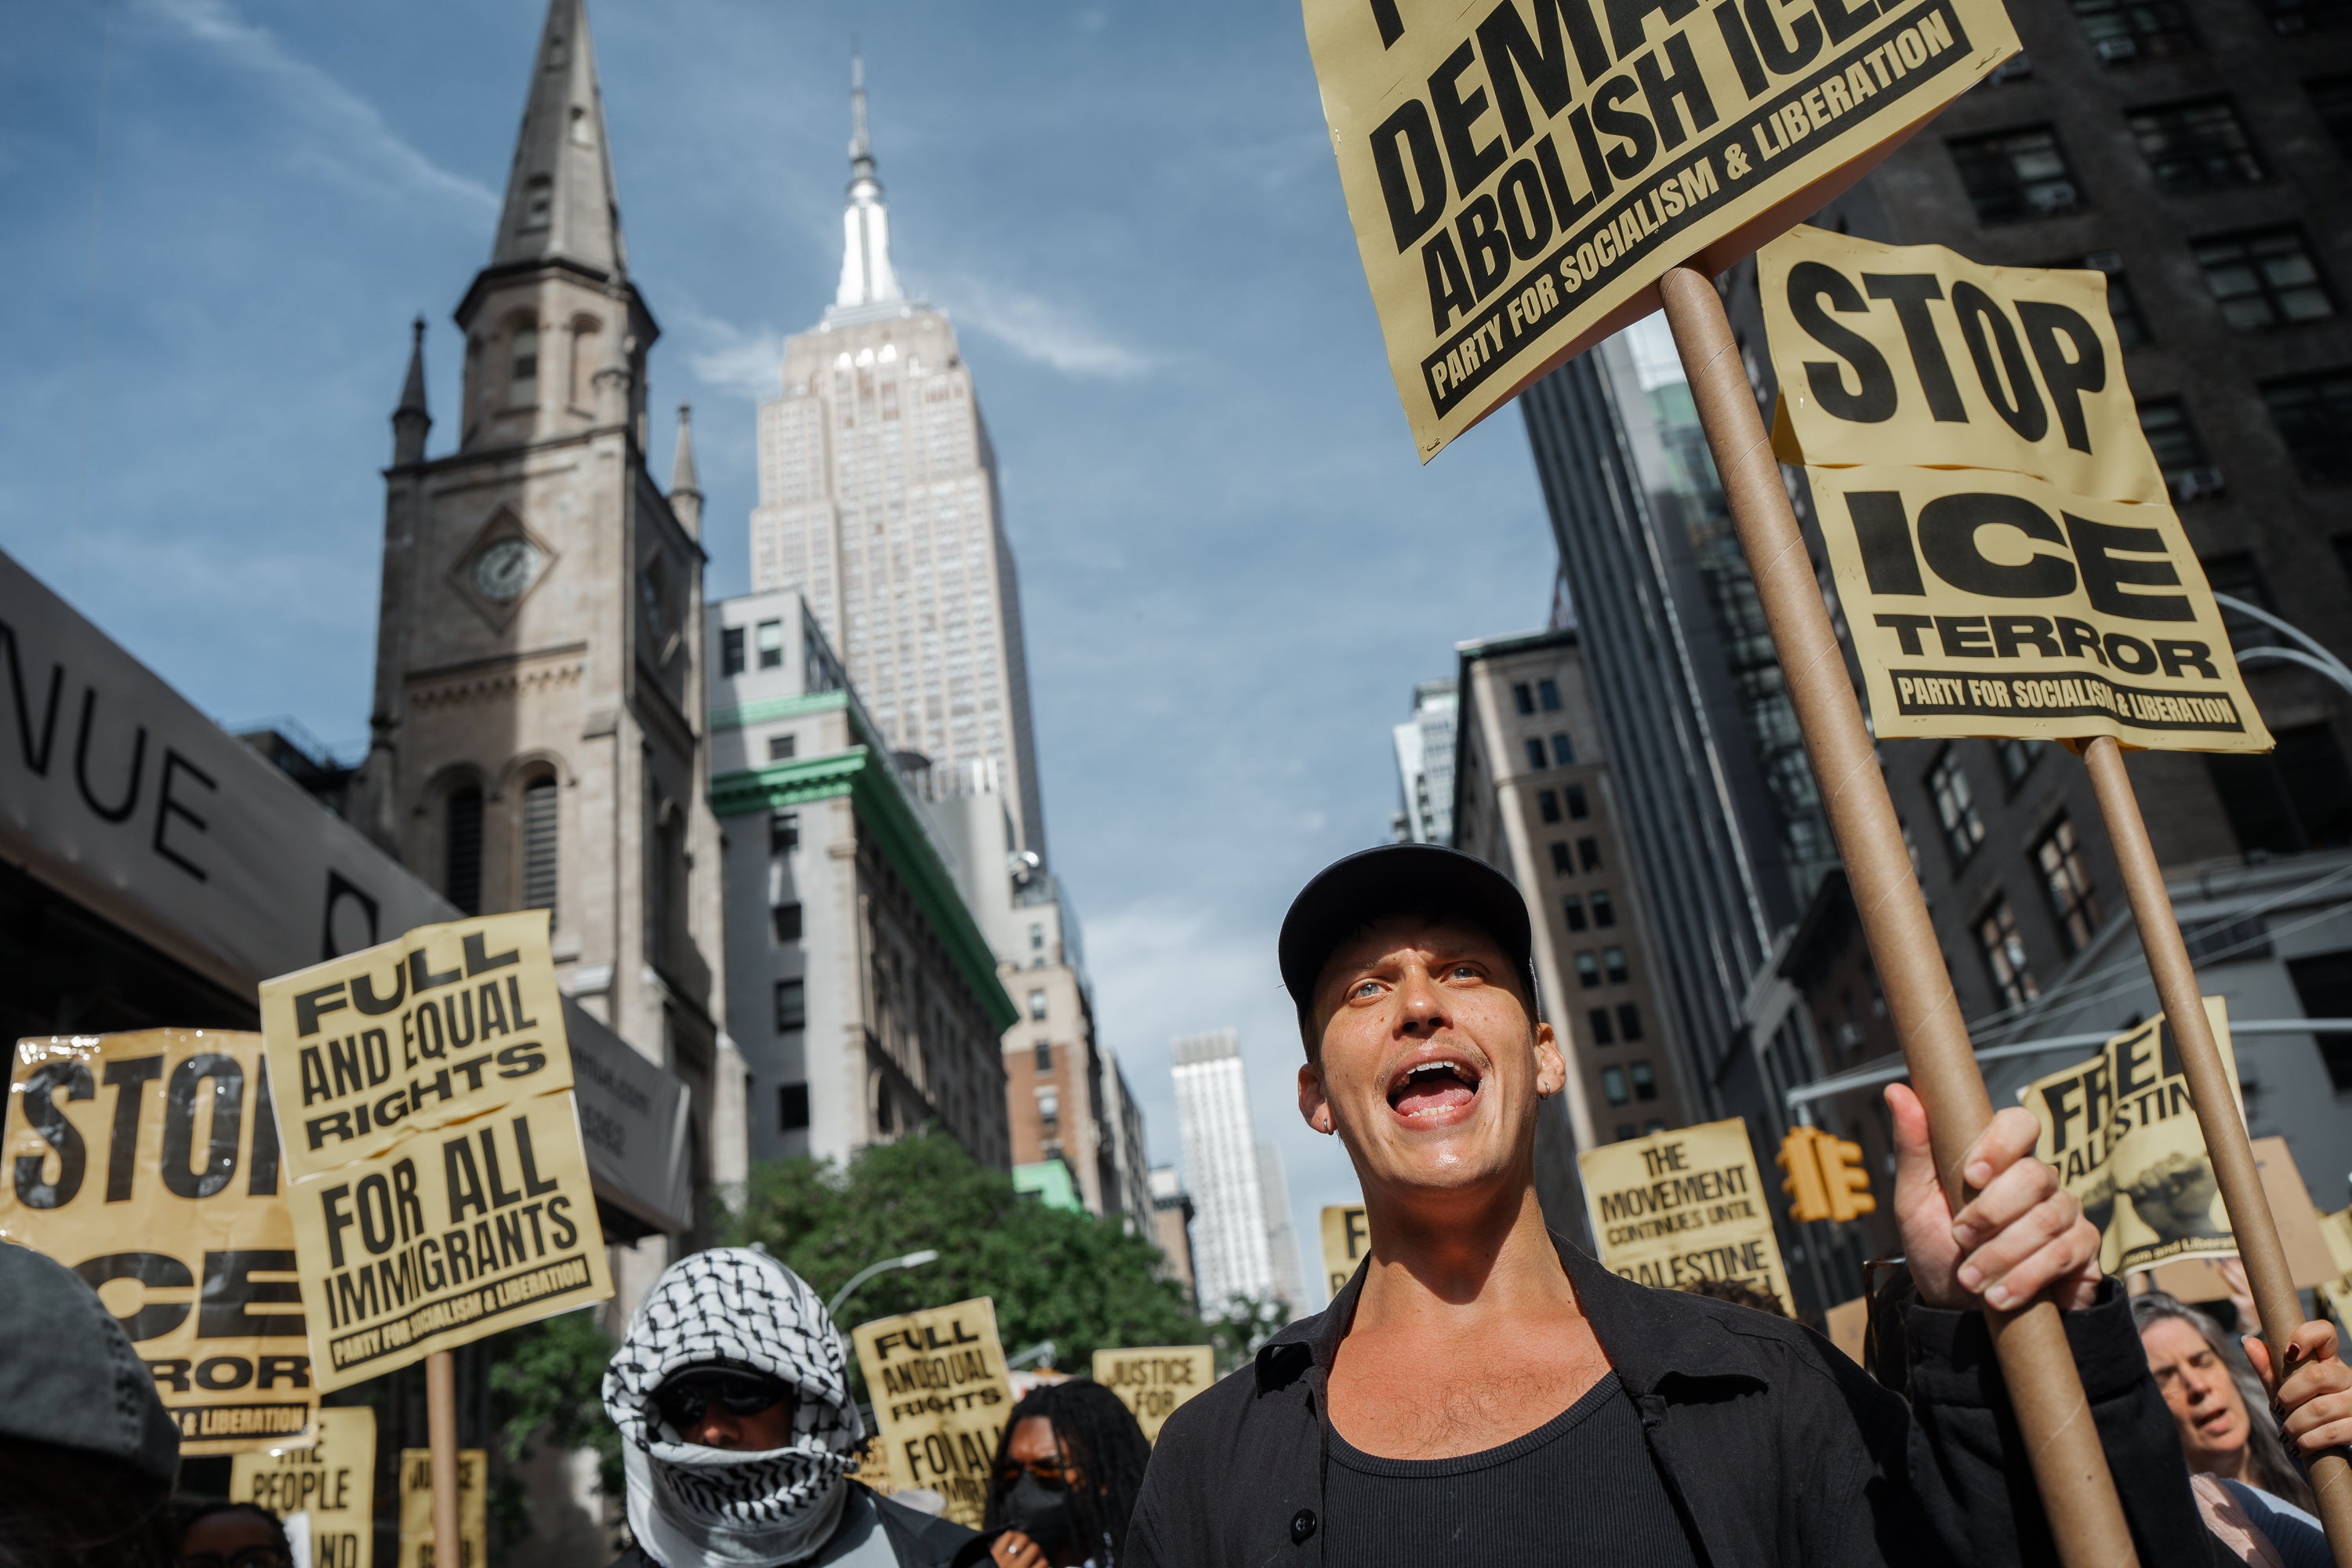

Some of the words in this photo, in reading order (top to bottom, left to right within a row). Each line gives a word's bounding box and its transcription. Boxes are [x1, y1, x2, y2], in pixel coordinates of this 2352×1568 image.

[1370, 0, 1701, 255] DEM
[1421, 29, 1720, 338] ABOLISH
[1431, 314, 1504, 400] PARTY
[1507, 274, 1559, 337] FOR
[1560, 156, 1719, 293] SOCIALISM
[1724, 143, 1753, 180] &
[1752, 9, 1955, 162] LIBERATION
[1787, 260, 2107, 456] STOP
[1843, 491, 2198, 622] ICE
[1873, 614, 2221, 679] TERROR
[1897, 676, 1965, 706] PARTY
[1969, 677, 2012, 707] FOR
[2014, 678, 2116, 711] SOCIALISM
[2116, 692, 2132, 717] &
[2132, 692, 2238, 724] LIBERATION
[294, 930, 521, 1038] FULL
[300, 1026, 391, 1107] AND
[404, 974, 537, 1069] EQUAL
[304, 1040, 547, 1152] RIGHTS
[1641, 1142, 1690, 1177] THE
[320, 1156, 426, 1270] FOR
[442, 1115, 558, 1225] ALL
[1600, 1166, 1748, 1222] MOVEMENT
[1608, 1210, 1704, 1246] CONTINUES
[1706, 1200, 1758, 1229] UNTIL
[323, 1196, 579, 1330] IMMIGRANTS
[332, 1330, 382, 1367] PARTY
[382, 1320, 412, 1350] FOR
[410, 1292, 484, 1340] SOCIALISM
[483, 1293, 498, 1312] &
[495, 1258, 587, 1309] LIBERATION
[874, 1320, 979, 1360] FULL
[882, 1359, 929, 1396] AND
[892, 1387, 1002, 1421] RIGHTS
[1106, 1358, 1193, 1386] JUSTICE
[1136, 1391, 1174, 1417] FOR
[182, 1412, 199, 1436] &
[200, 1406, 305, 1436] LIBERATION
[252, 1468, 350, 1512] PEOPLE
